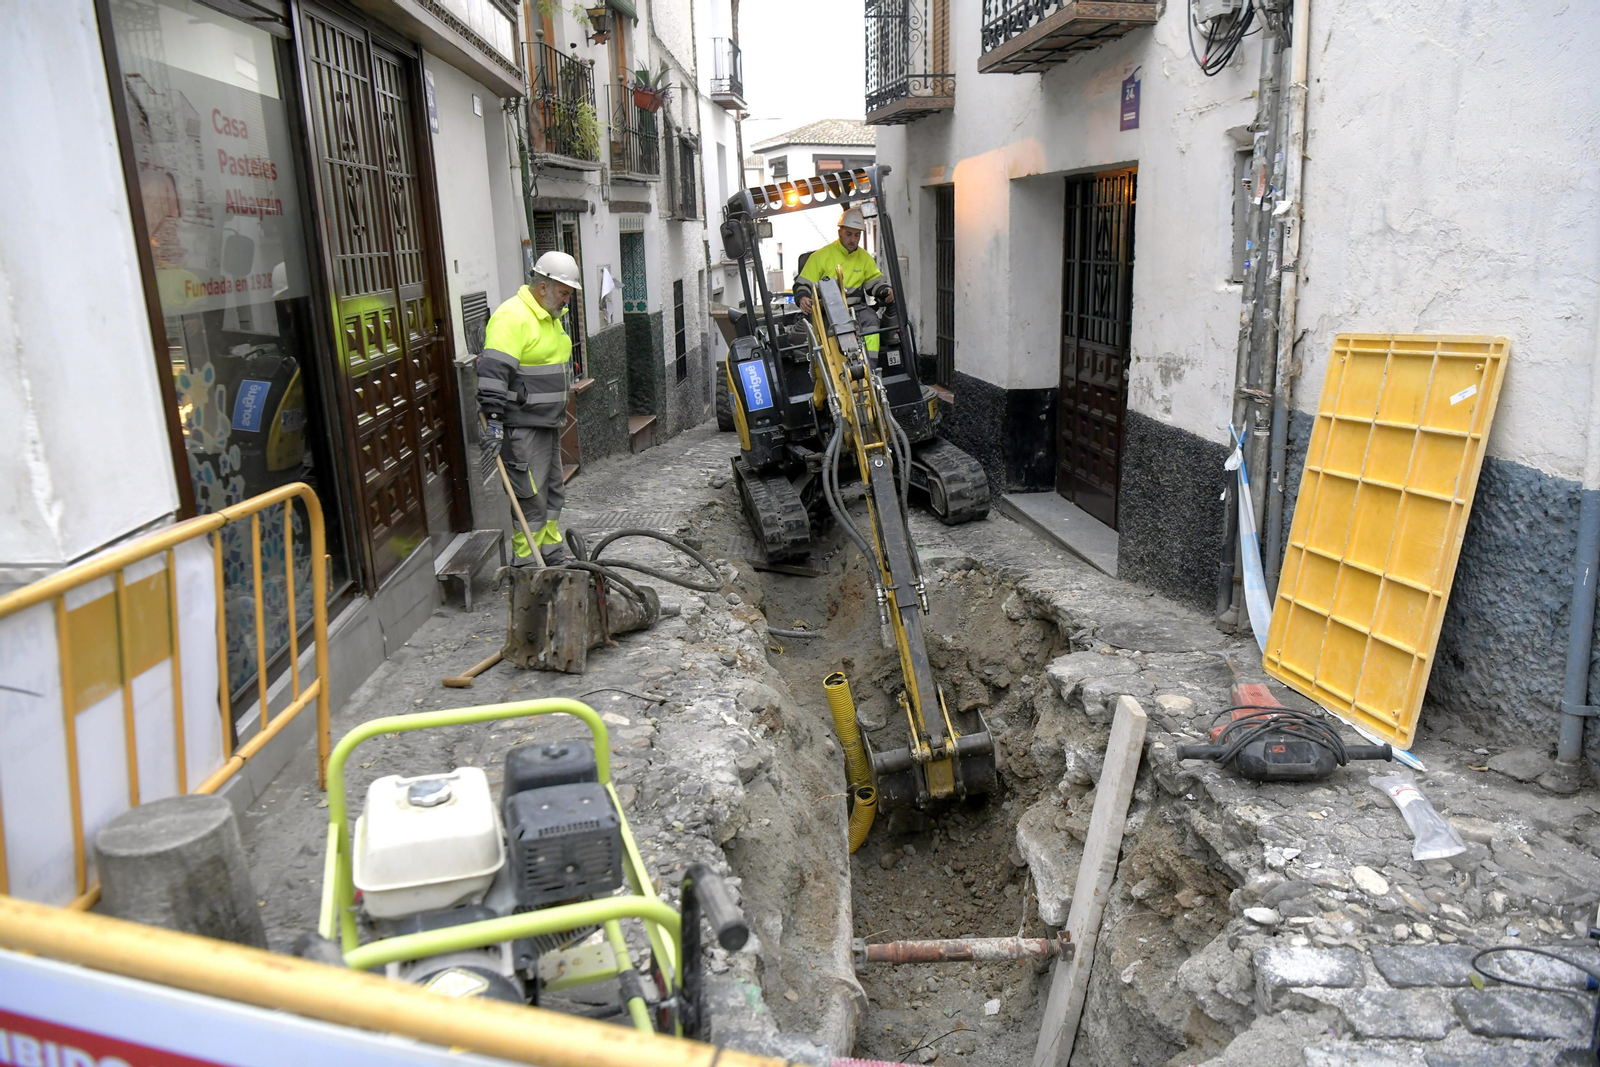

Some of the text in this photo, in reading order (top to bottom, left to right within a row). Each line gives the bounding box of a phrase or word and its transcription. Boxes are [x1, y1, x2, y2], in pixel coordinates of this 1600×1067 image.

[211, 108, 249, 140] Casa
[217, 149, 277, 180] Pasteles
[184, 272, 273, 299] Fundada en 1928
[745, 365, 764, 405] sorigué
